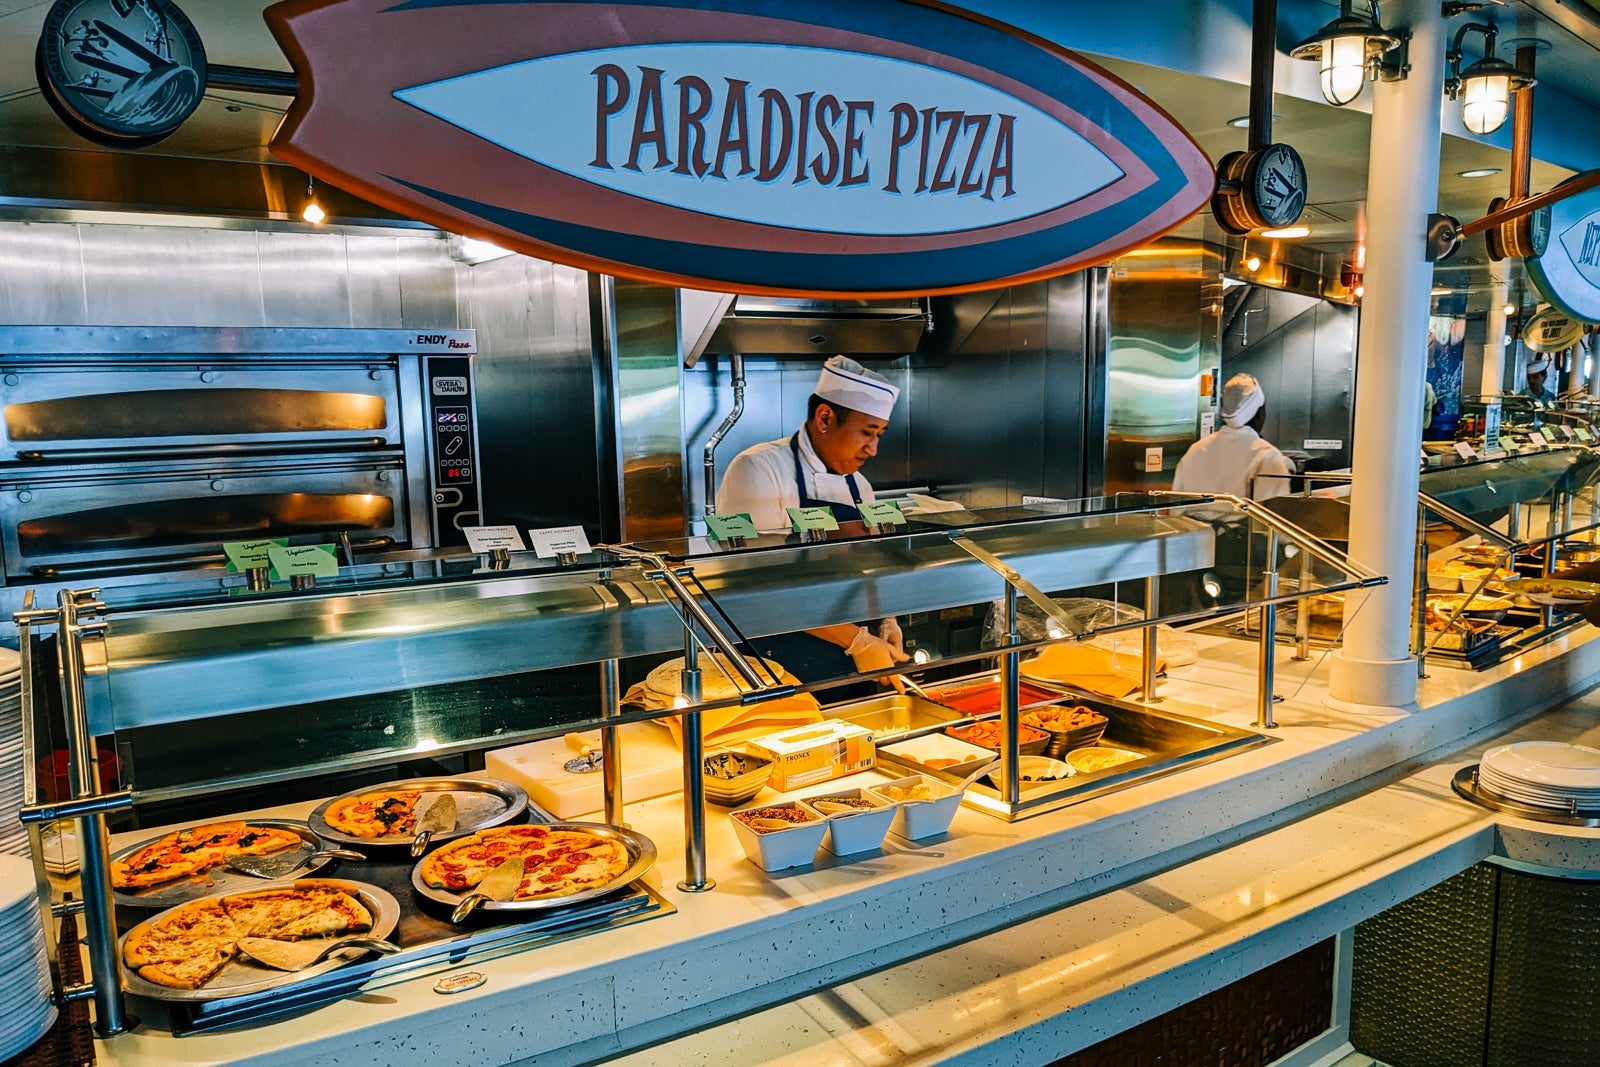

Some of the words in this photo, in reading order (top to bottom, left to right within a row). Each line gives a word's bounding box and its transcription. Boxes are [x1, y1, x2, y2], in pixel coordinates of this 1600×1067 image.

[588, 63, 874, 187] PARADISE
[882, 101, 1017, 202] PIZZA
[447, 339, 472, 349] Pizza
[241, 542, 271, 550] Vegetarian
[285, 548, 315, 556] Vegetarian
[785, 751, 811, 762] TRONEX
